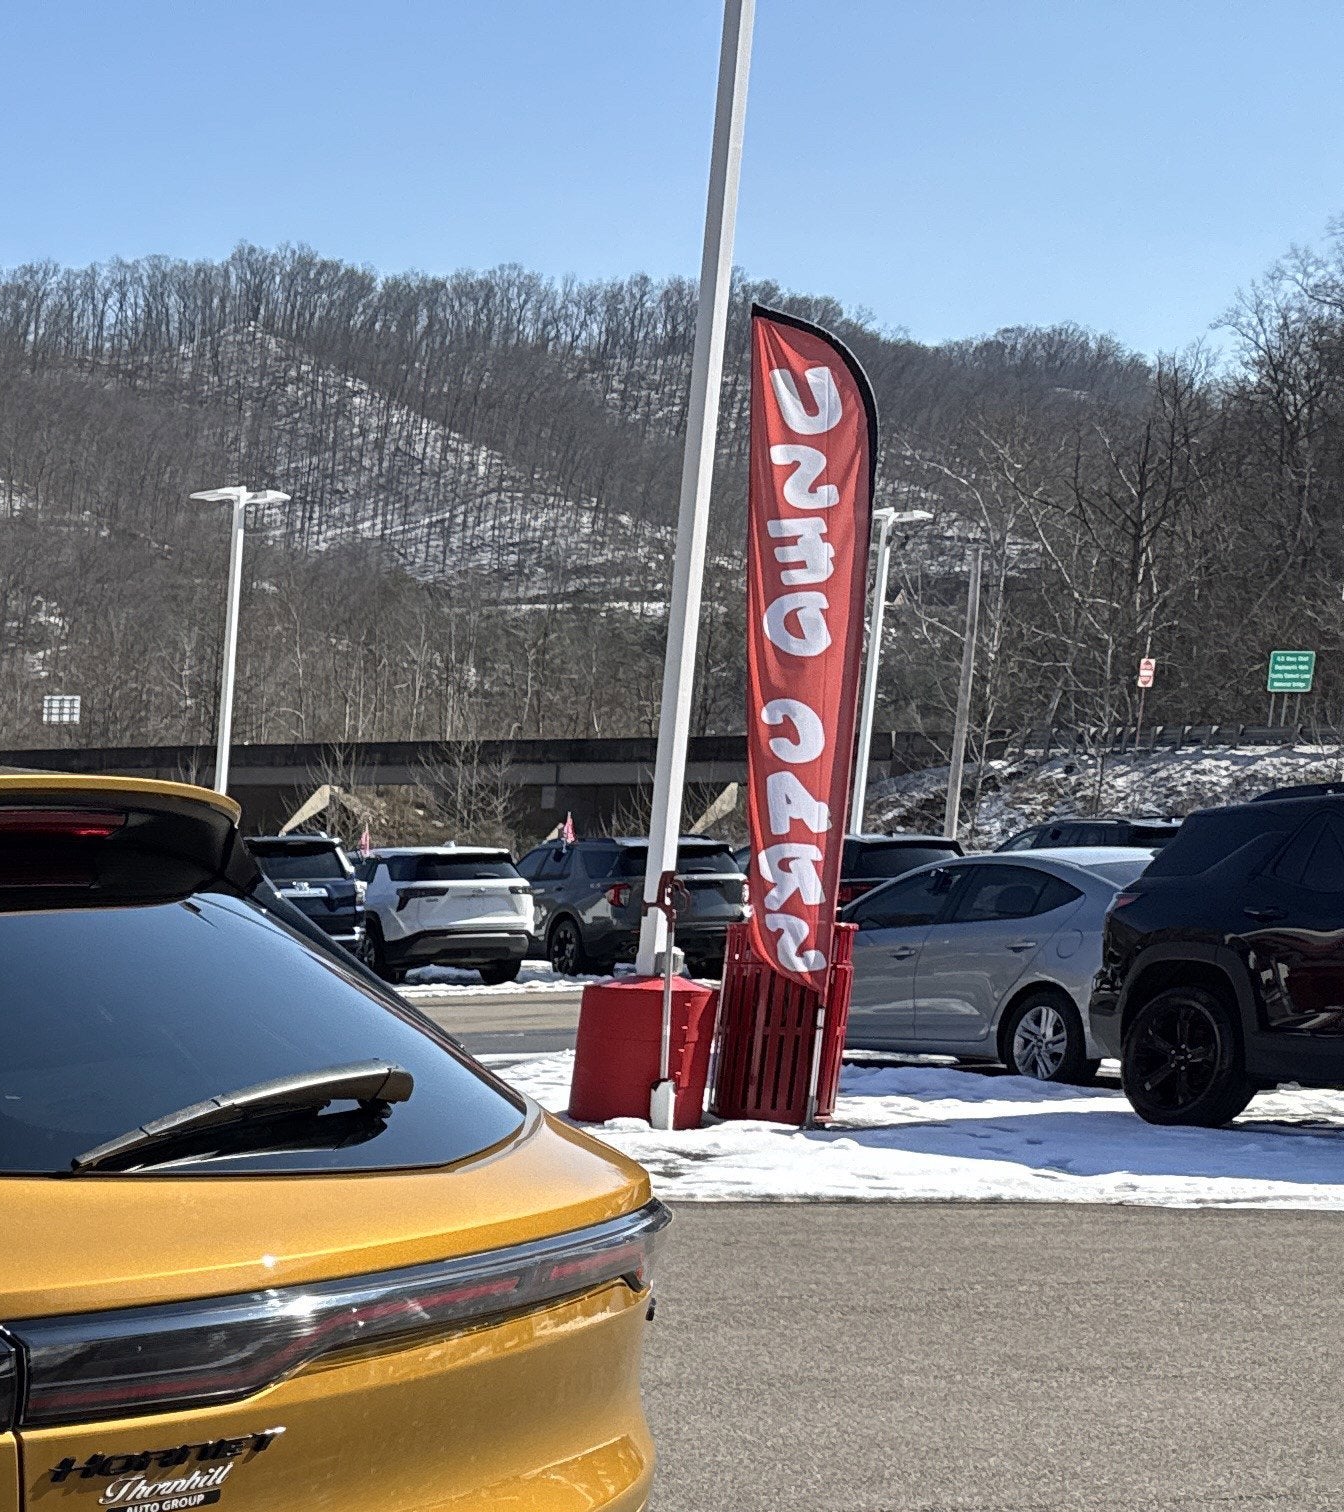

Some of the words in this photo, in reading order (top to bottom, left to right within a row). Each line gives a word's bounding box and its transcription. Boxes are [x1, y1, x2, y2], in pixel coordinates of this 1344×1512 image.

[49, 1426, 286, 1483] HORNET
[98, 1461, 235, 1504] Thornhill
[161, 1492, 205, 1512] GROUP
